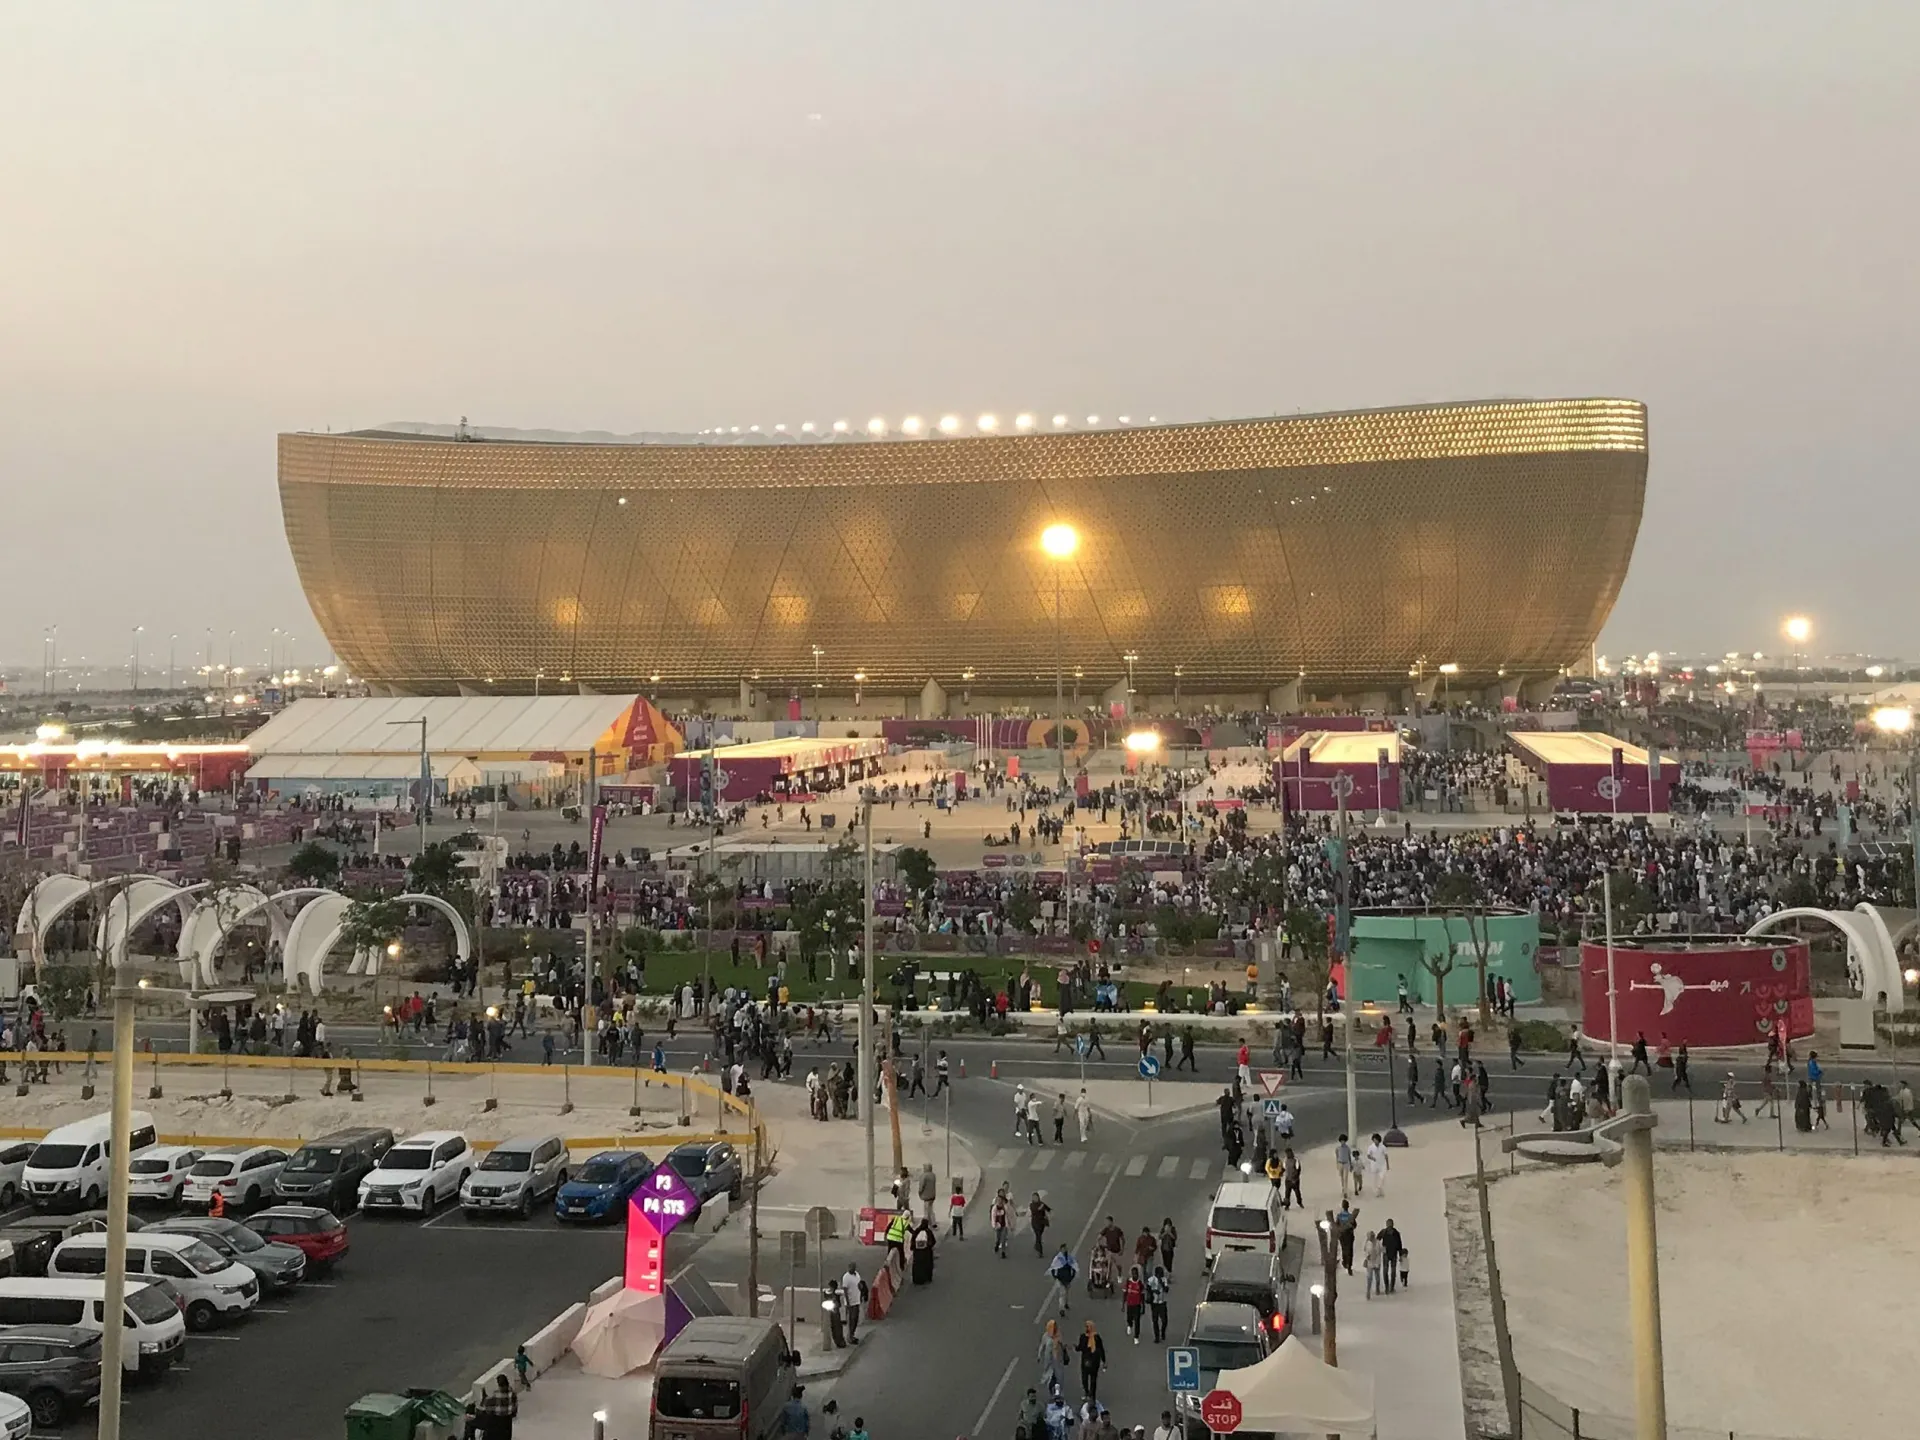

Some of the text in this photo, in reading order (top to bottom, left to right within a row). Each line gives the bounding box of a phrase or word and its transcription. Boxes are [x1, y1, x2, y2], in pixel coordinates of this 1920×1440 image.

[656, 1174, 671, 1190] P3
[643, 1197, 660, 1214] P4
[1174, 1351, 1192, 1375] P
[1210, 1397, 1232, 1410] قف
[1207, 1413, 1237, 1424] STOP
